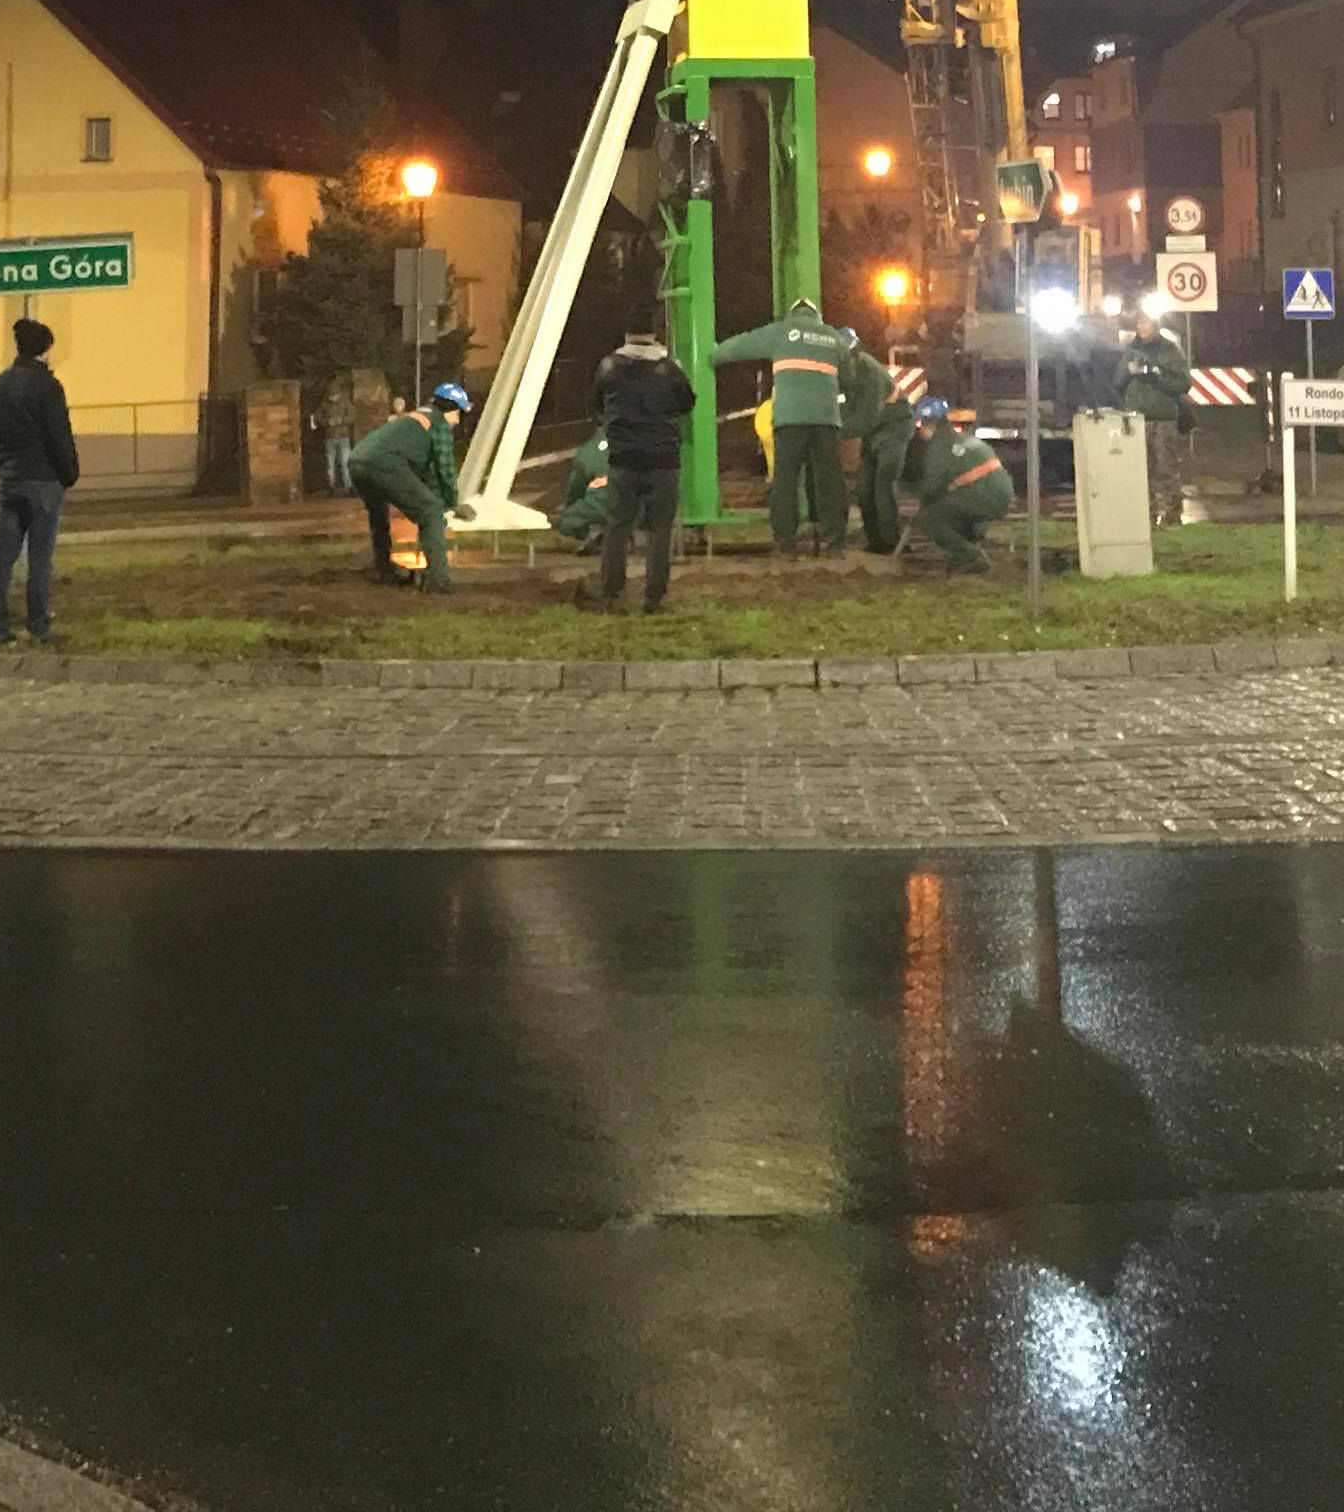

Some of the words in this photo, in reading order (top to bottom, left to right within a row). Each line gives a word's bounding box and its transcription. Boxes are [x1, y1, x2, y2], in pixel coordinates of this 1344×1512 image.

[49, 253, 123, 280] Góra
[1174, 272, 1202, 292] 30
[1305, 386, 1344, 399] Rondo
[1289, 406, 1300, 418] 11
